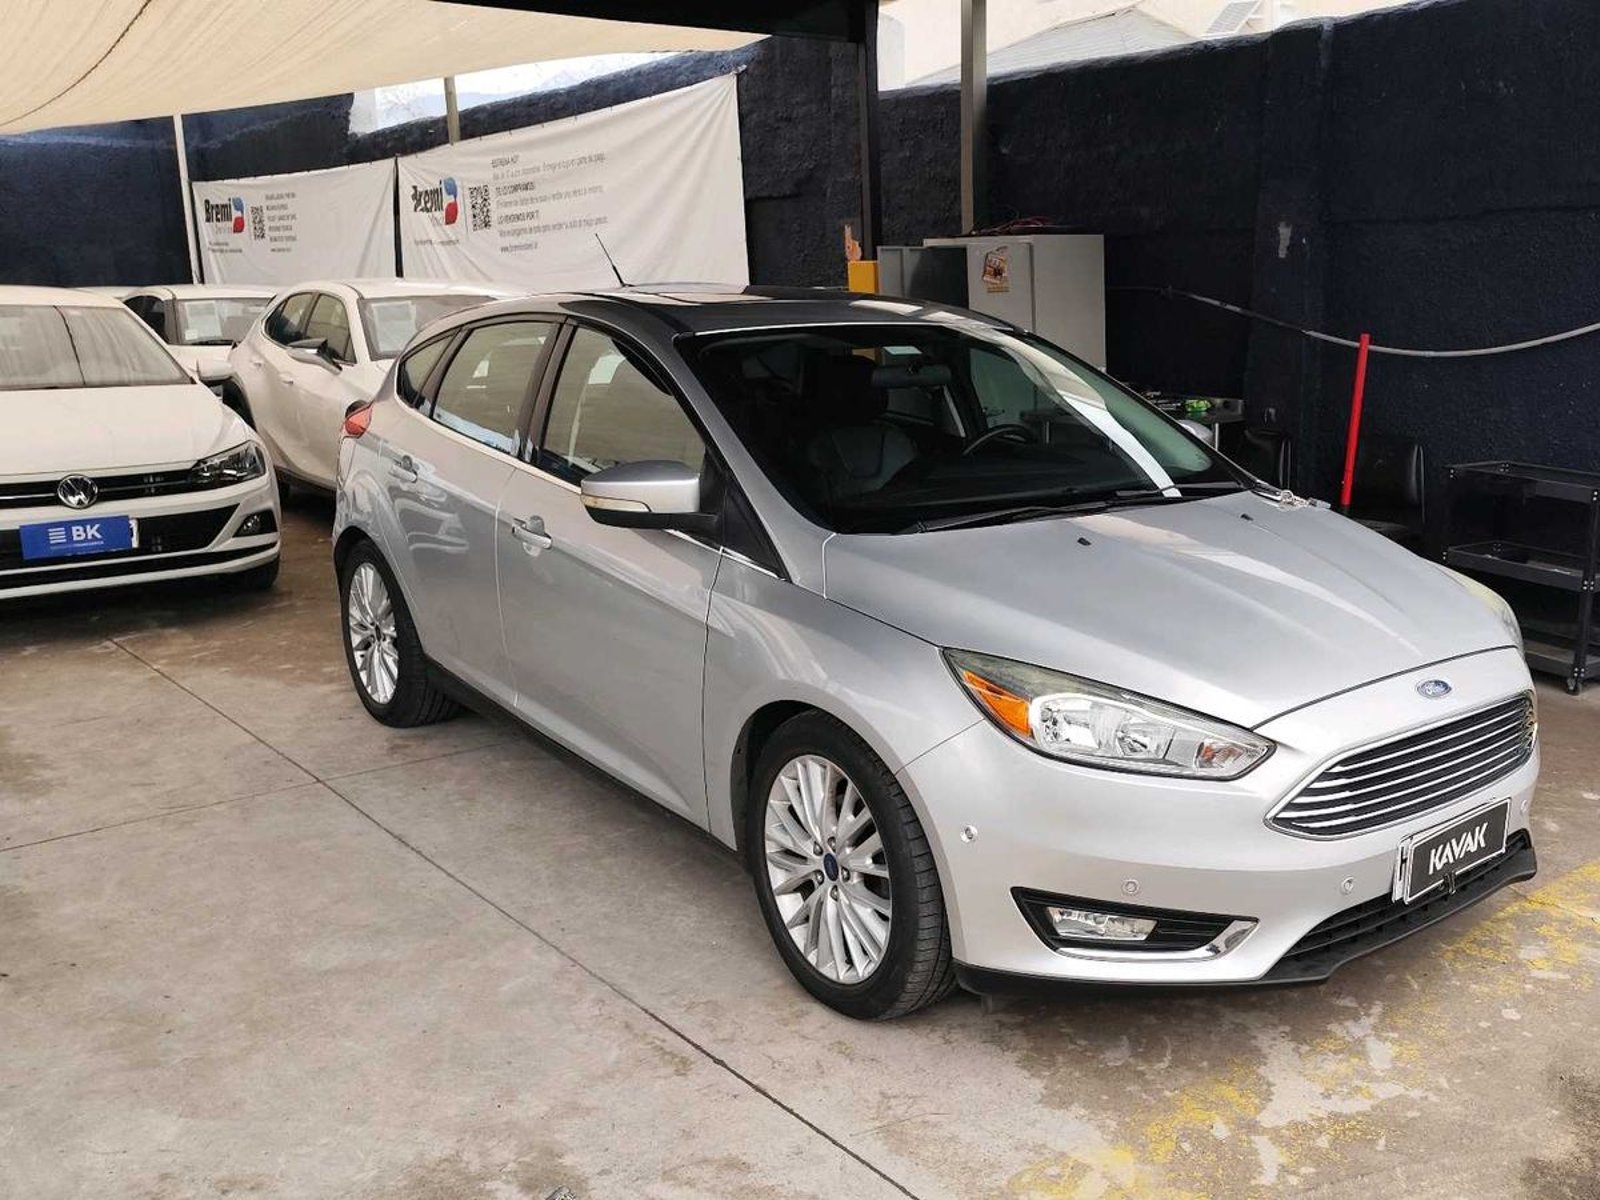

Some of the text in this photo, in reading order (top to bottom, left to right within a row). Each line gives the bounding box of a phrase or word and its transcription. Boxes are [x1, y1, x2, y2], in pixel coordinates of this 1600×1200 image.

[204, 197, 232, 223] Bremi
[71, 523, 102, 541] BK
[1428, 822, 1488, 874] KAVAK
